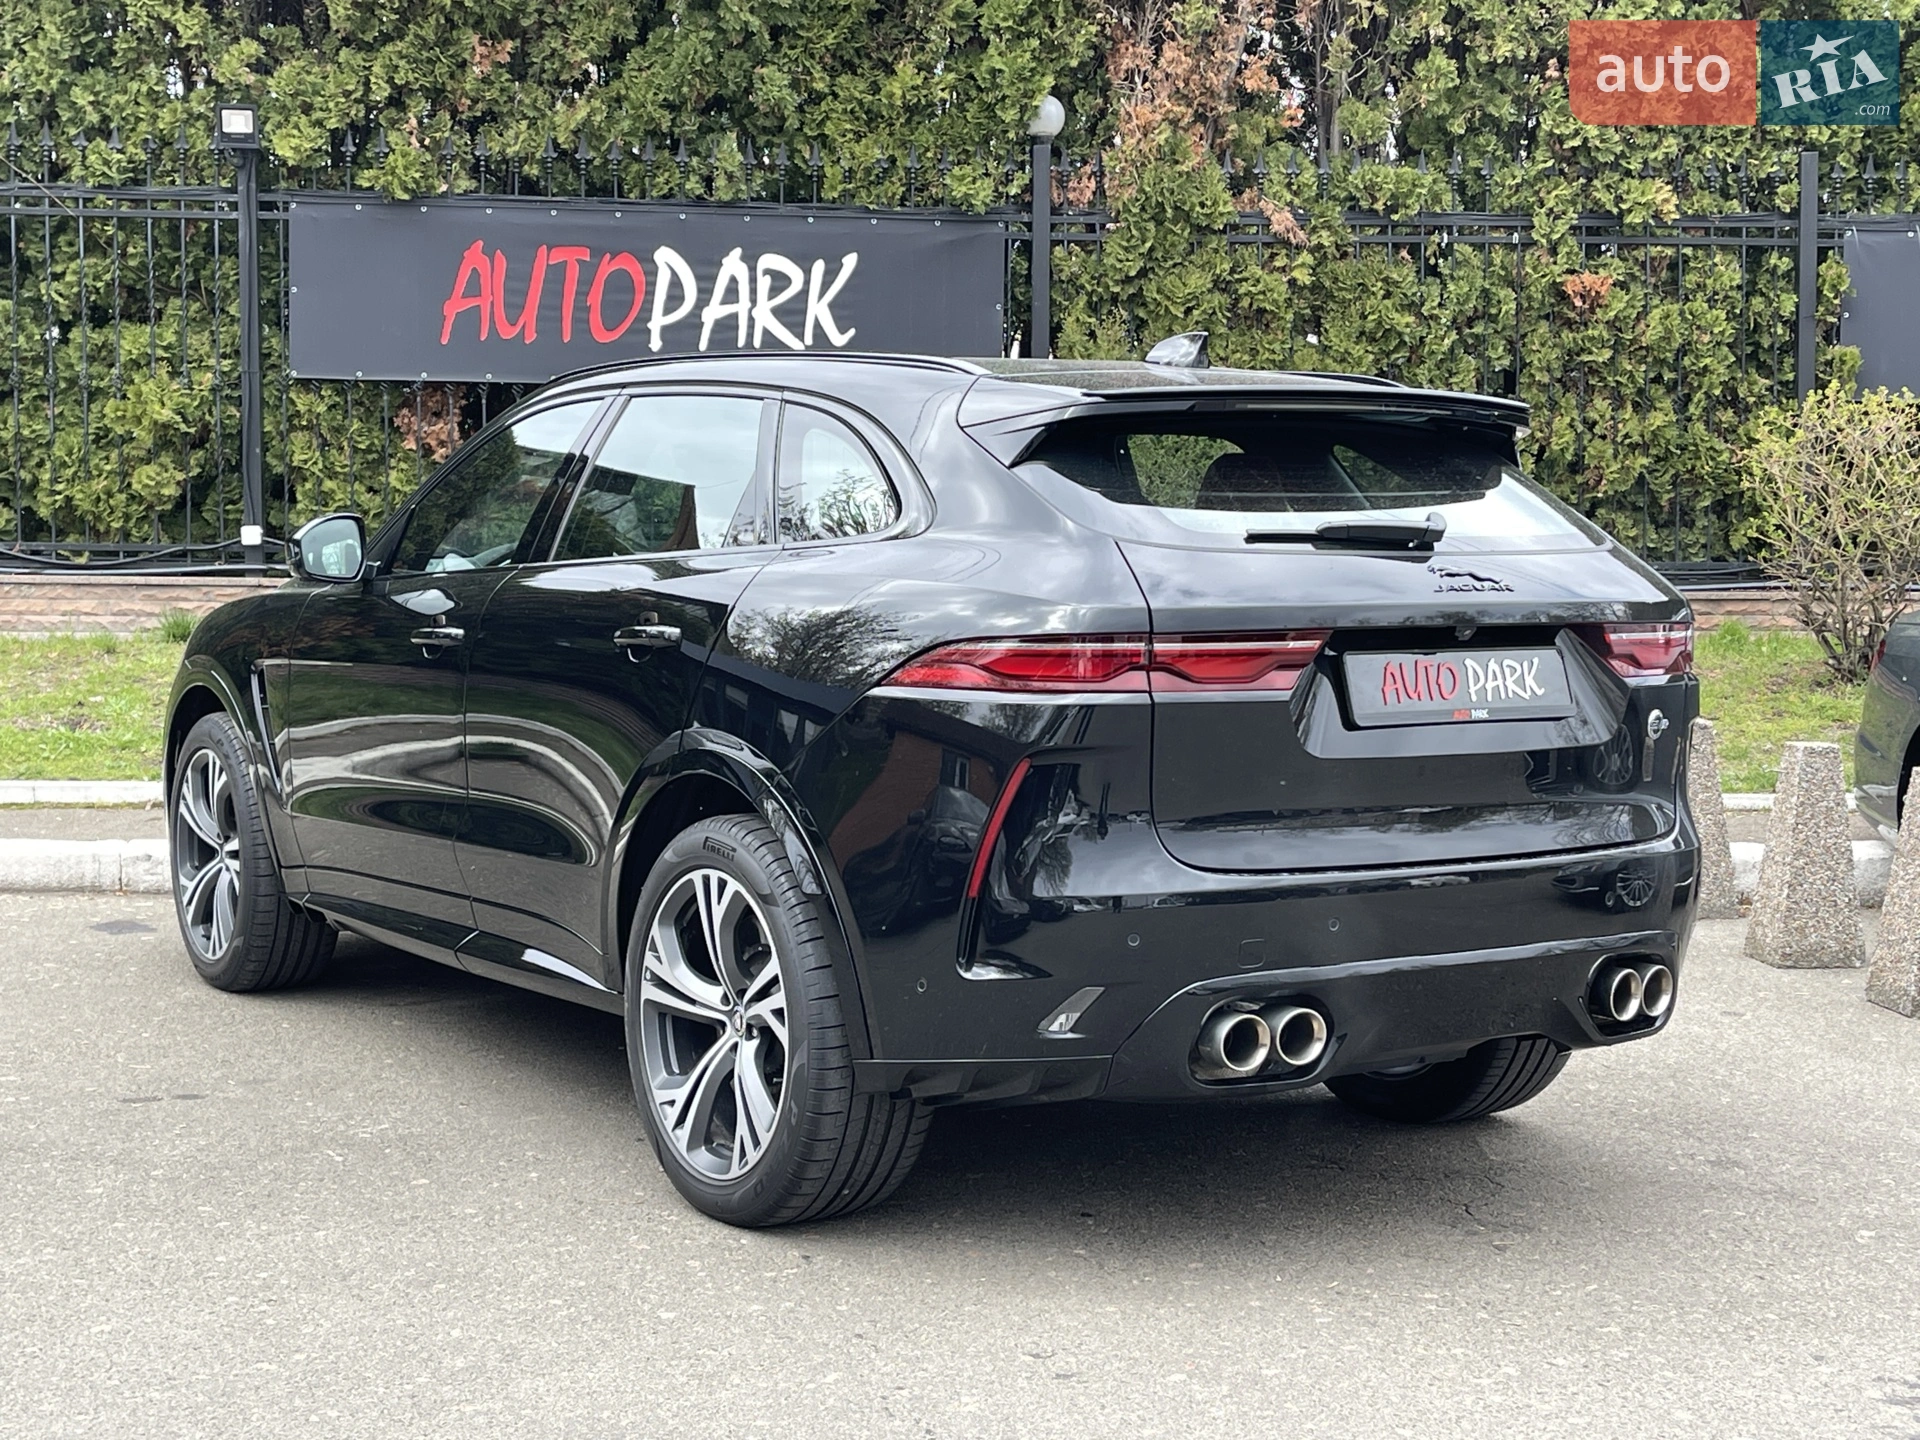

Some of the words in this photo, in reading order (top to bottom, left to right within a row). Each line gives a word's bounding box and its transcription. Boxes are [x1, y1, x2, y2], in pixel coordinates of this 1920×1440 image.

[1433, 584, 1515, 593] JAGUAR
[1381, 659, 1460, 706] AUTO
[1463, 657, 1545, 702] PARK
[702, 835, 737, 862] PIRELLI
